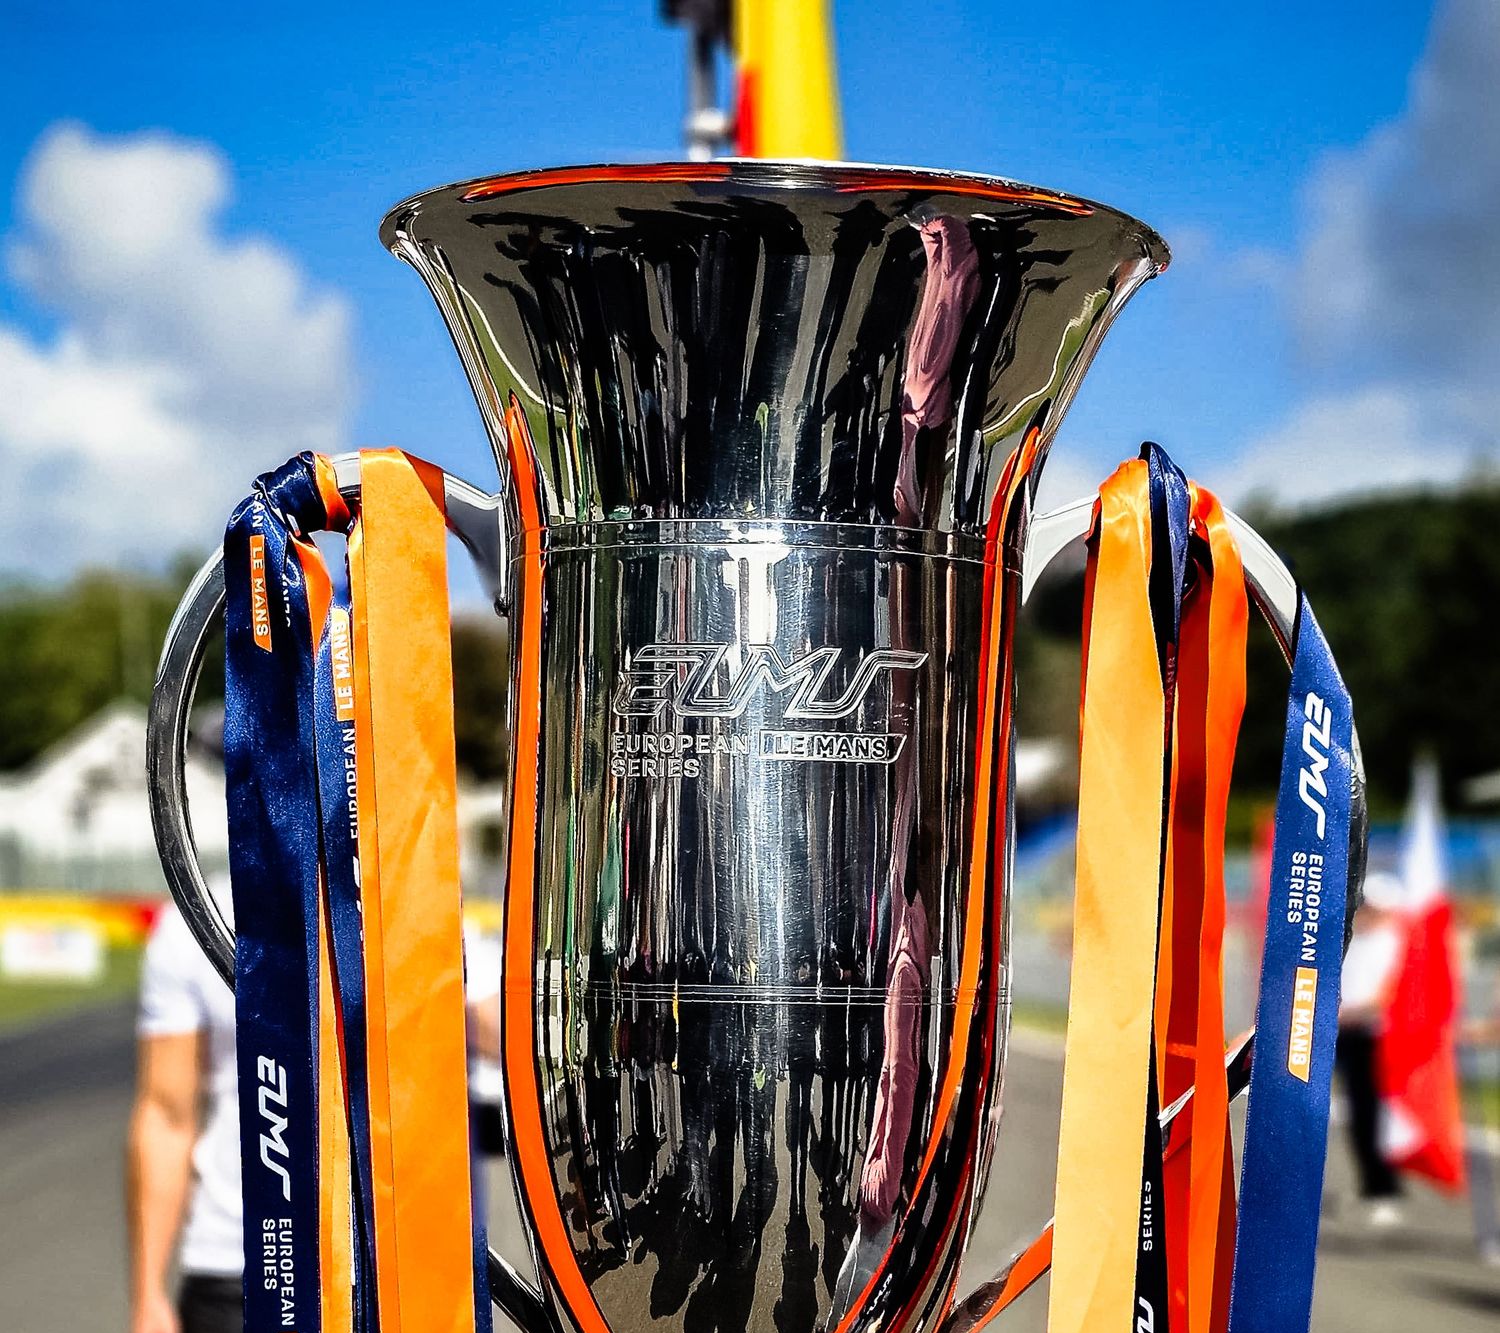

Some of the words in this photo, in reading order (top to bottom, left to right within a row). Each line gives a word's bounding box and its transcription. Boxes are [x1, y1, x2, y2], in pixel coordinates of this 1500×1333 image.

[252, 546, 264, 569] LE
[253, 580, 269, 637] MANS
[337, 685, 354, 710] LE
[610, 732, 751, 755] EUROPEAN
[775, 734, 807, 756] LE
[816, 735, 888, 759] MANS
[610, 757, 701, 778] SERIES
[1287, 851, 1308, 925] SERIES
[1301, 854, 1325, 962] EUROPEAN
[1296, 978, 1314, 1004] LE
[1289, 1008, 1313, 1066] MANS
[262, 1218, 278, 1291] SERIES
[278, 1218, 295, 1326] EUROPEAN
